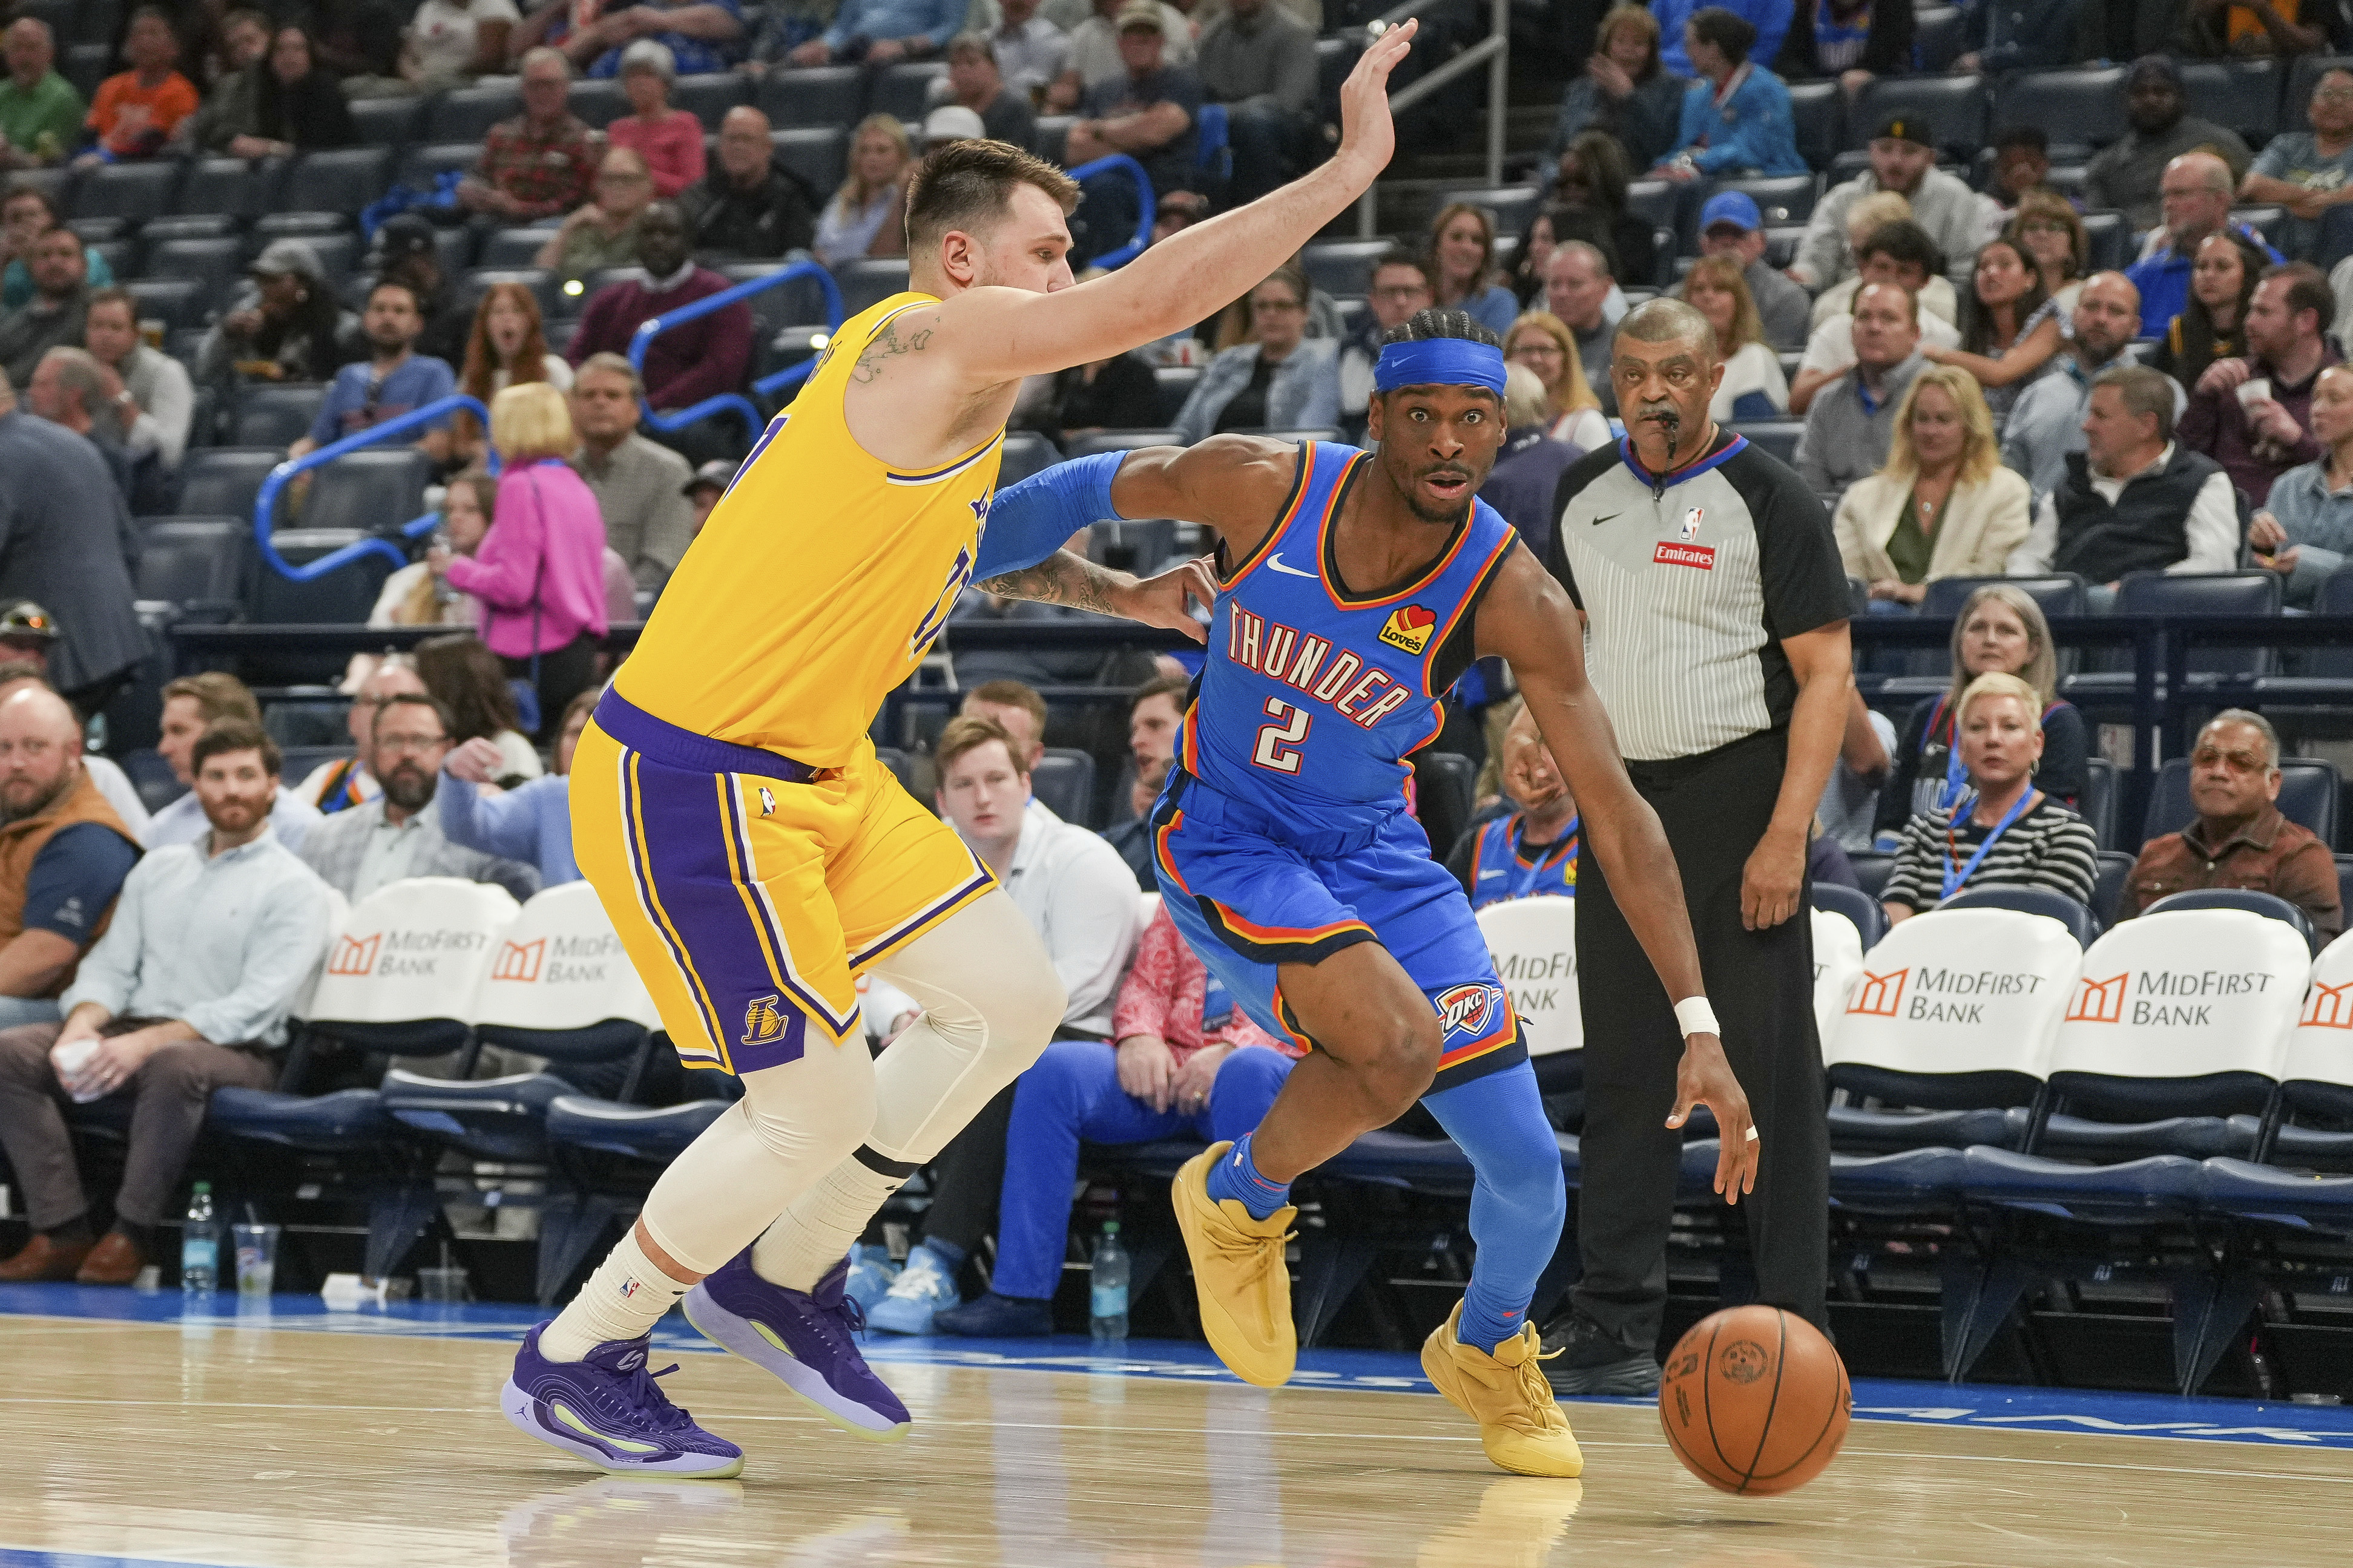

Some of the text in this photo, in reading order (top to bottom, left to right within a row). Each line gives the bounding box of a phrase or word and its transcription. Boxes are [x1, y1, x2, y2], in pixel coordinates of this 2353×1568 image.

[1656, 546, 1713, 565] Emirates
[1228, 597, 1412, 730] THUNDER
[1250, 695, 1314, 776] 2
[1490, 952, 1578, 981] MIDFI
[1443, 990, 1484, 1032] OKC
